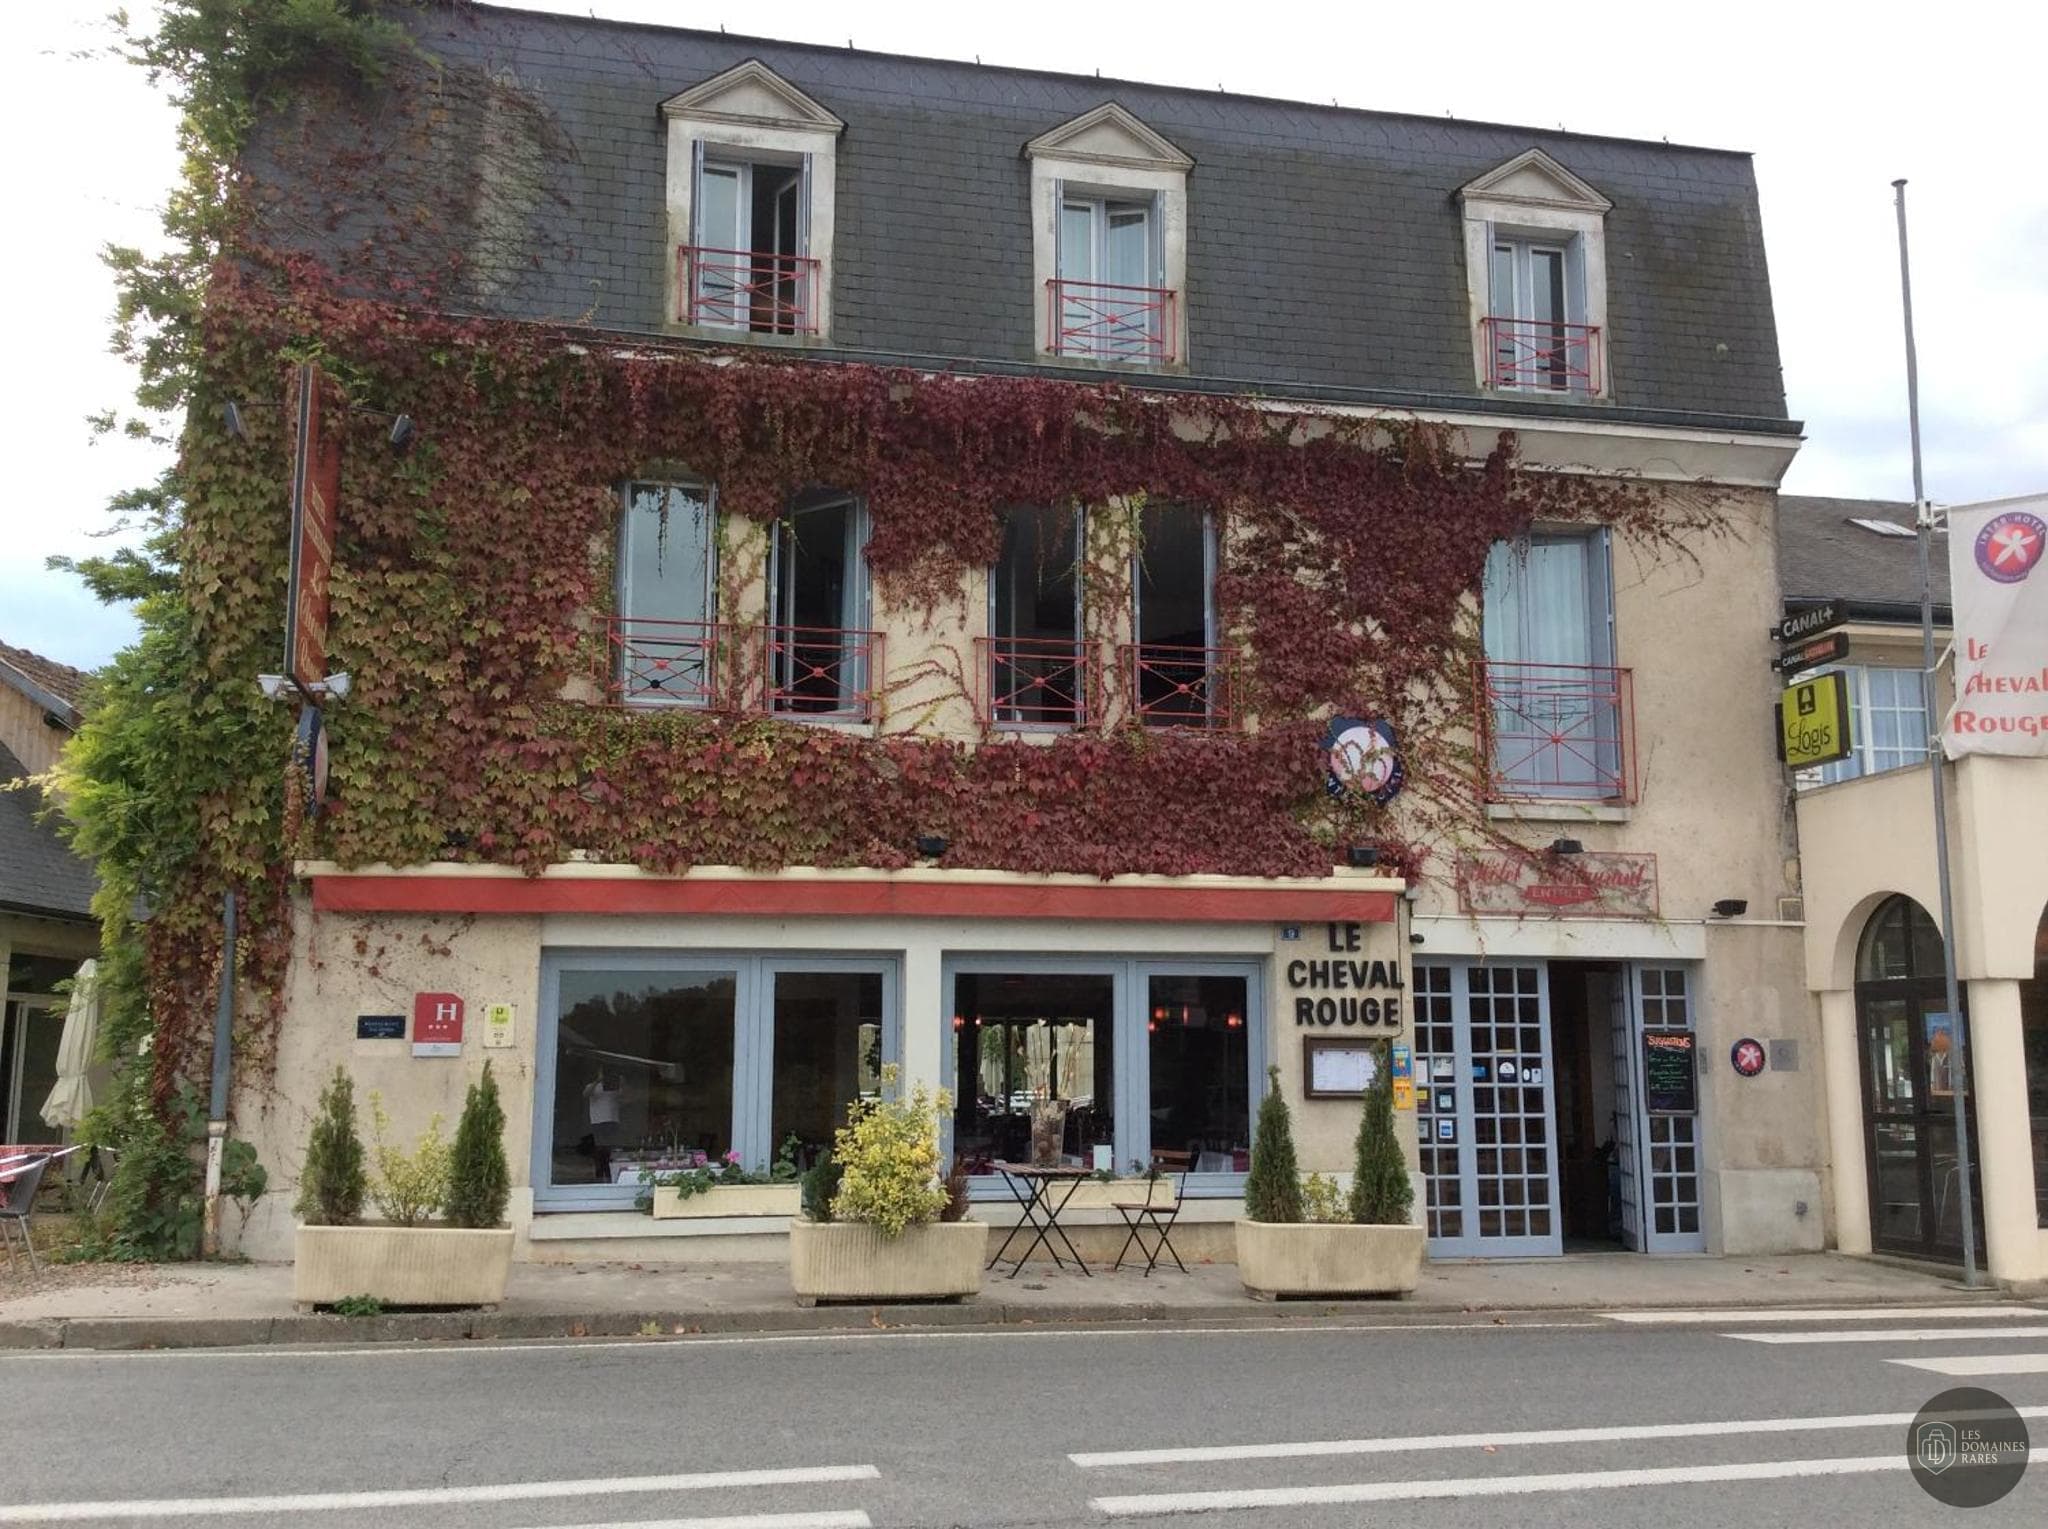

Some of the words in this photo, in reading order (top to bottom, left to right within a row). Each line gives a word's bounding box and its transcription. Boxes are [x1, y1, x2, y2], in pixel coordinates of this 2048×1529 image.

[1783, 606, 1834, 637] CANAL+
[1787, 717, 1831, 756] Logis
[1328, 921, 1361, 952] LE
[1287, 959, 1405, 990] CHEVAL
[436, 1003, 457, 1021] H
[1295, 997, 1399, 1026] ROUGE
